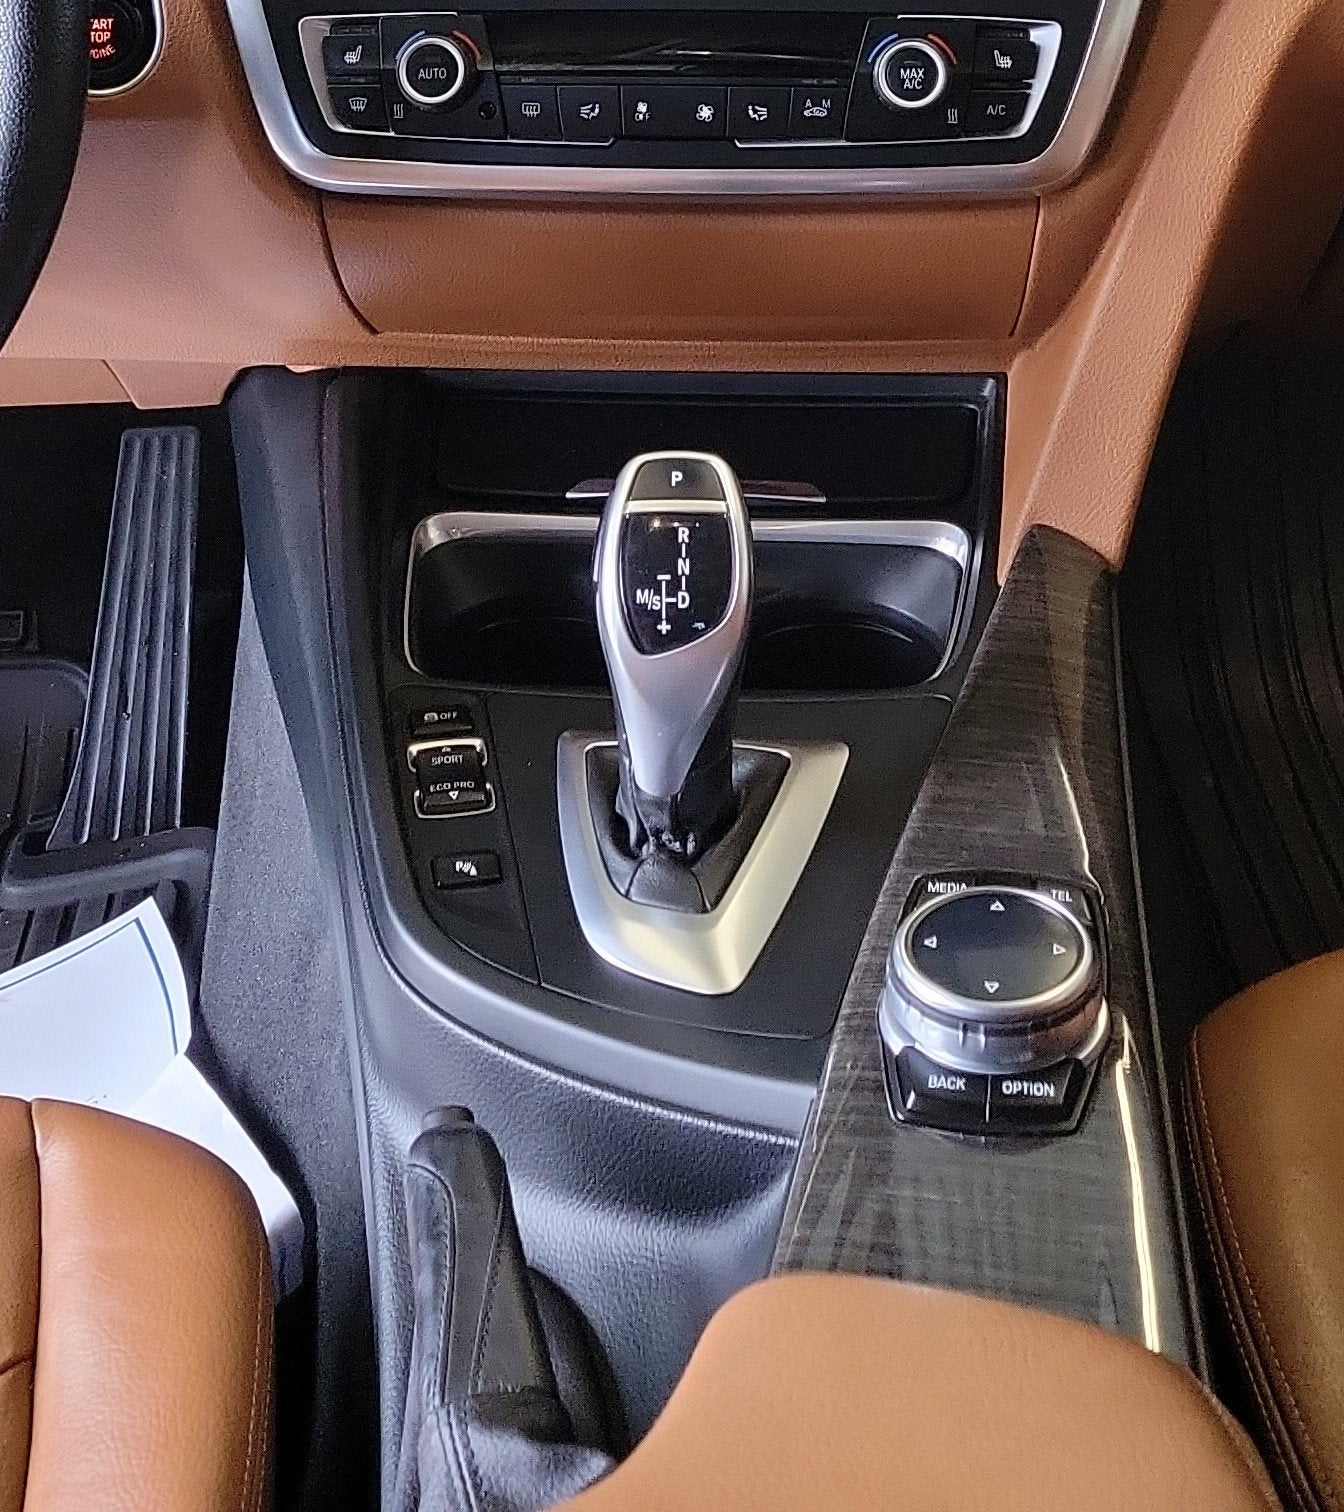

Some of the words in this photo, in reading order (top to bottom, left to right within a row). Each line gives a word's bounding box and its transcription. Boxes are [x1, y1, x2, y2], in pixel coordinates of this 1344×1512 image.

[90, 18, 114, 30] ART
[90, 31, 111, 43] TOP
[418, 67, 447, 80] AUTO
[900, 68, 925, 80] MAX
[903, 78, 923, 90] A/C
[804, 99, 812, 108] A
[822, 99, 831, 108] M
[986, 104, 1006, 116] A/C
[671, 471, 683, 487] P
[677, 526, 690, 543] R
[677, 558, 690, 576] N
[677, 591, 690, 609] D
[431, 754, 464, 766] SPORT
[430, 782, 452, 793] ECO
[453, 779, 475, 790] PRO
[927, 1074, 967, 1091] BACK
[1001, 1080, 1056, 1097] OPTION
